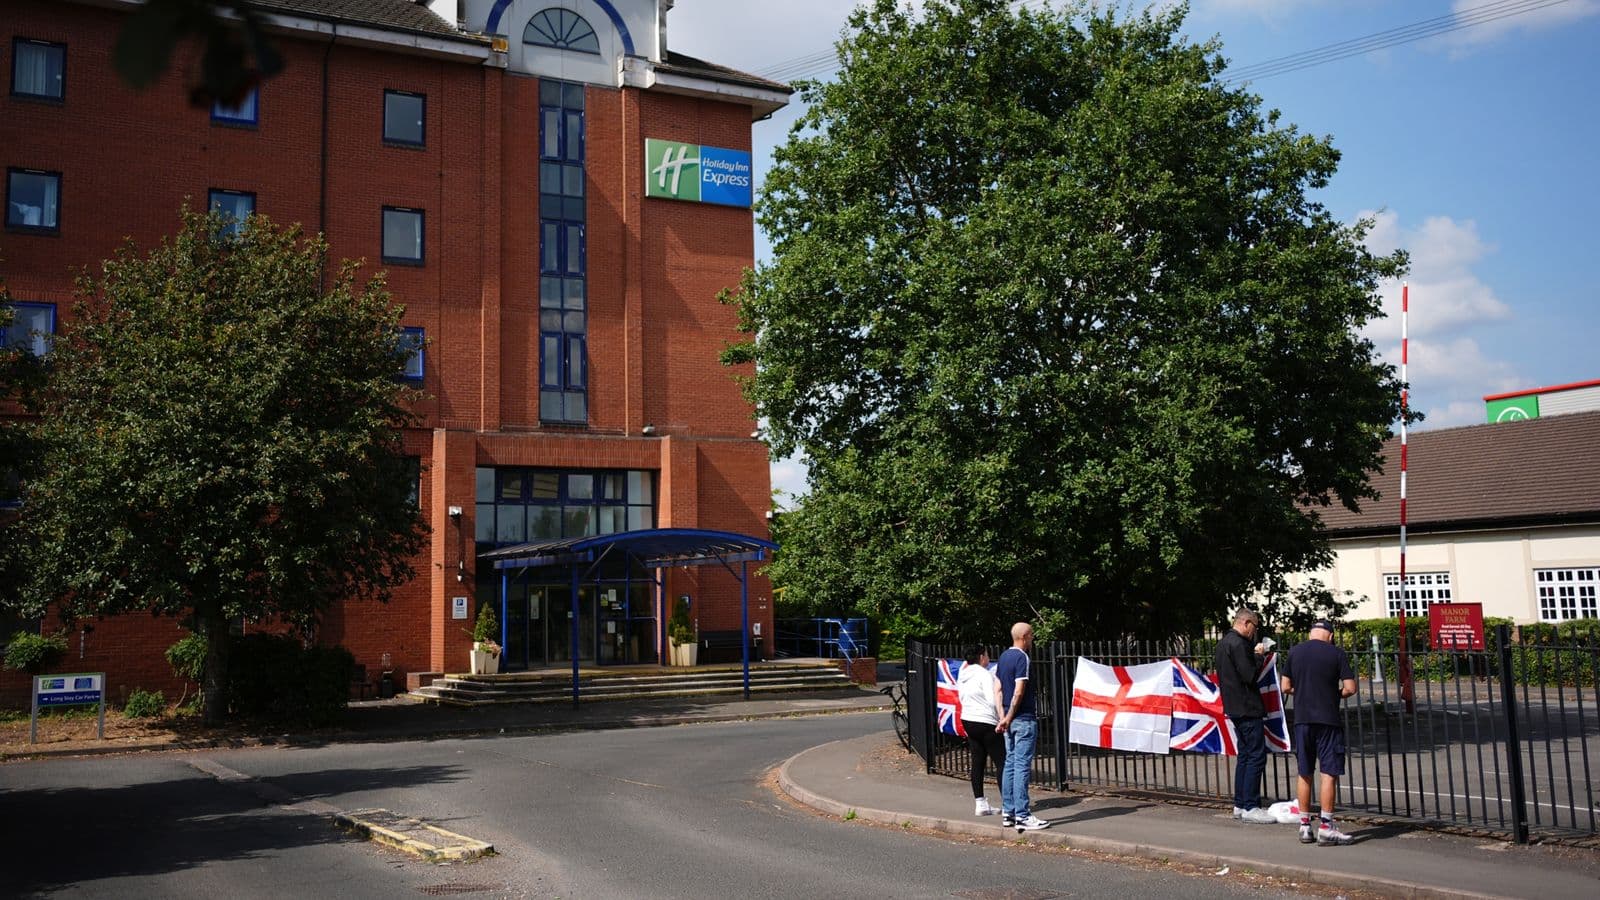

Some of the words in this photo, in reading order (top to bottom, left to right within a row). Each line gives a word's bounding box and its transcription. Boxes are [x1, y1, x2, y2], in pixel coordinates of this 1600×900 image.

[702, 157, 735, 172] Holiday
[735, 161, 749, 172] Inn
[703, 168, 749, 187] Express
[1440, 608, 1470, 616] MANOR
[1445, 616, 1466, 624] FARM
